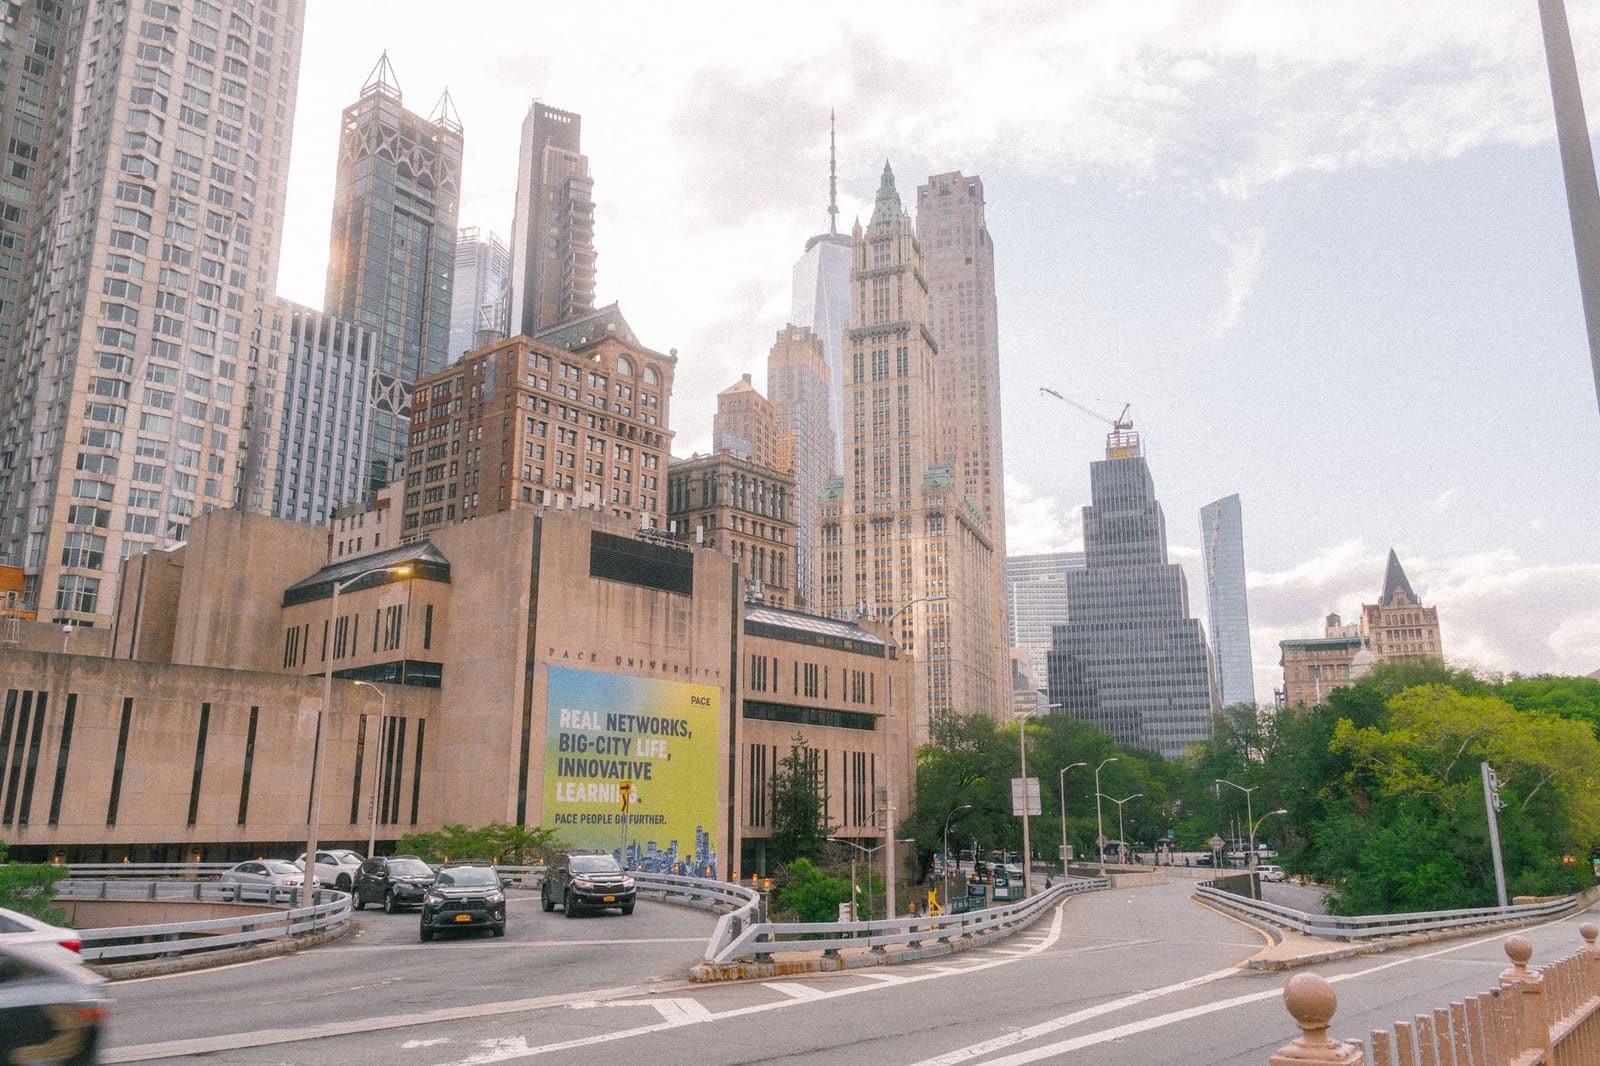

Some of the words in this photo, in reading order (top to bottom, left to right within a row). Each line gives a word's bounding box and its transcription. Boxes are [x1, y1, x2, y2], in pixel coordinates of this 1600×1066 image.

[549, 648, 597, 662] PACE
[615, 656, 720, 678] UNIVERSITY
[691, 696, 711, 706] PACE
[560, 709, 600, 730] REAL
[606, 713, 692, 739] NETWORKS,
[559, 733, 632, 756] BIG-CITY
[636, 739, 671, 761] LIFE,
[558, 757, 652, 780] INNOVATIVE
[555, 814, 578, 824] PACE
[580, 814, 612, 825] PEOPLE
[629, 815, 667, 825] FURTHER.
